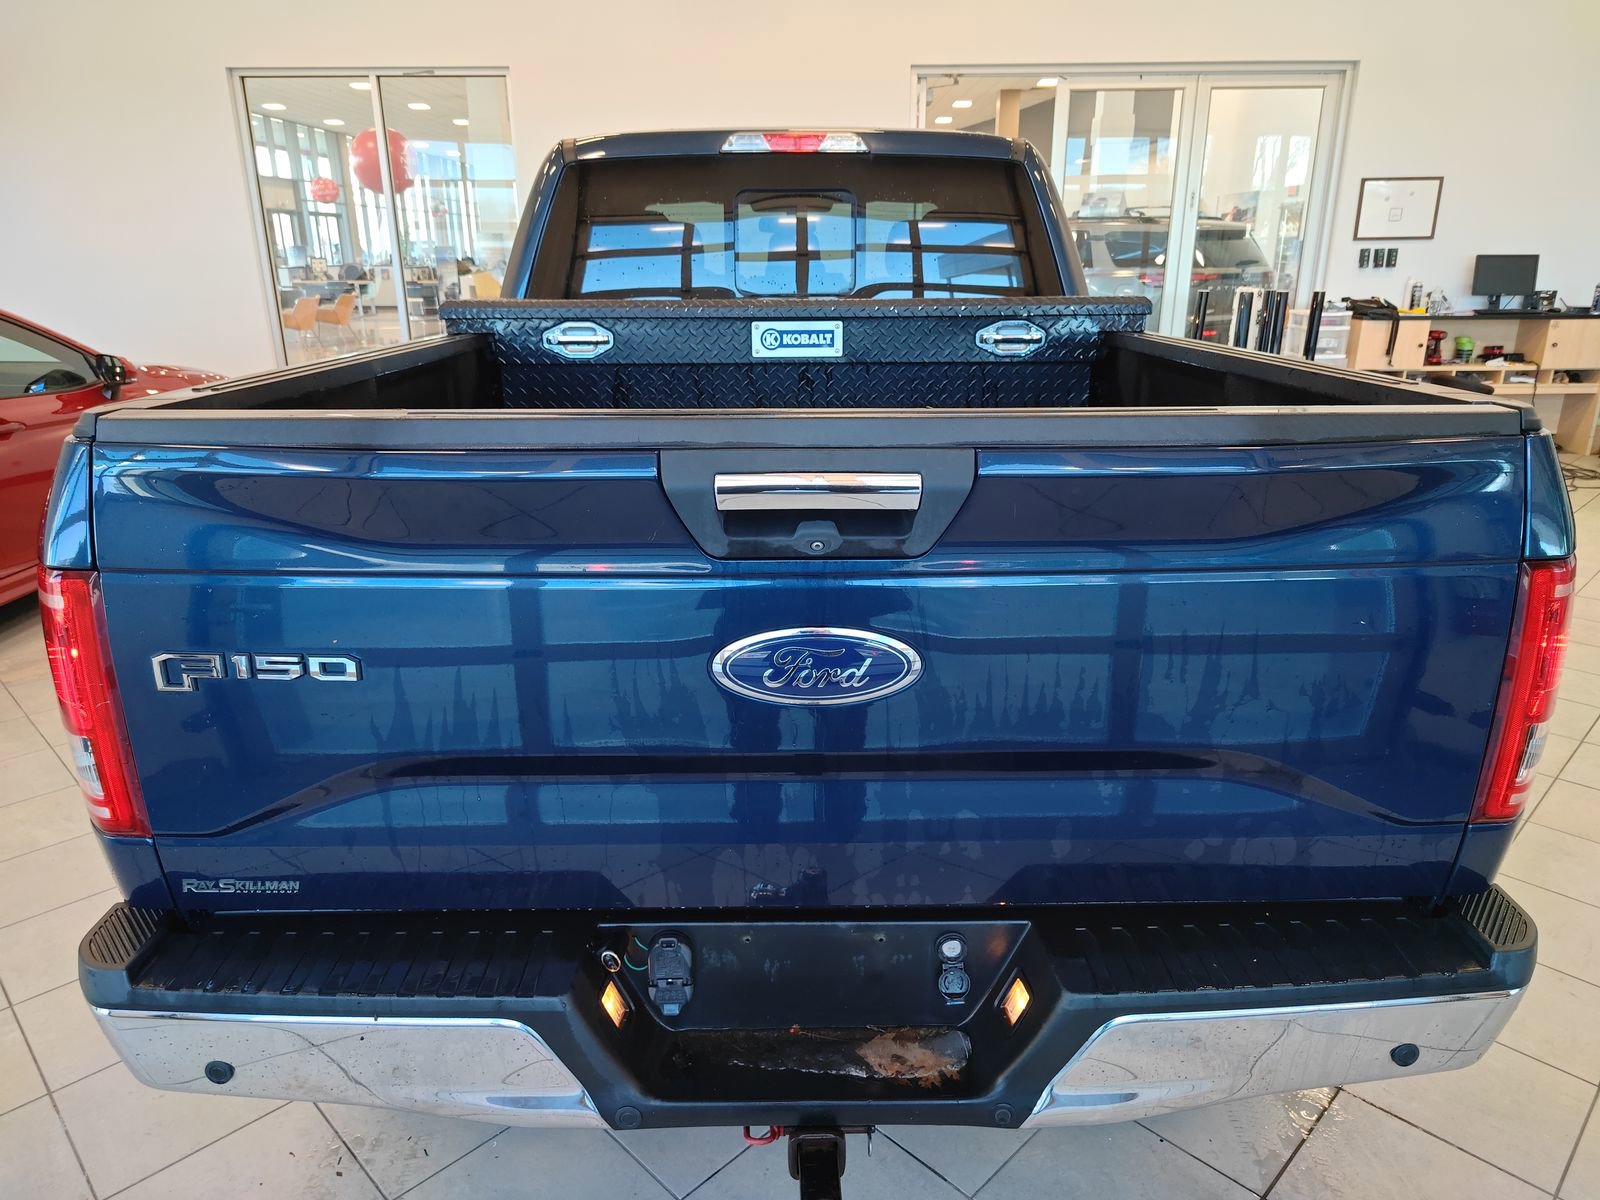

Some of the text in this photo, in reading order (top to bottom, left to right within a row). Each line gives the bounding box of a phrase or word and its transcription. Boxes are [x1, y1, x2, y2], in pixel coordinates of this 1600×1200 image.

[782, 333, 833, 345] KOBALT
[763, 646, 873, 688] Ford
[219, 878, 300, 893] SKILLMAN
